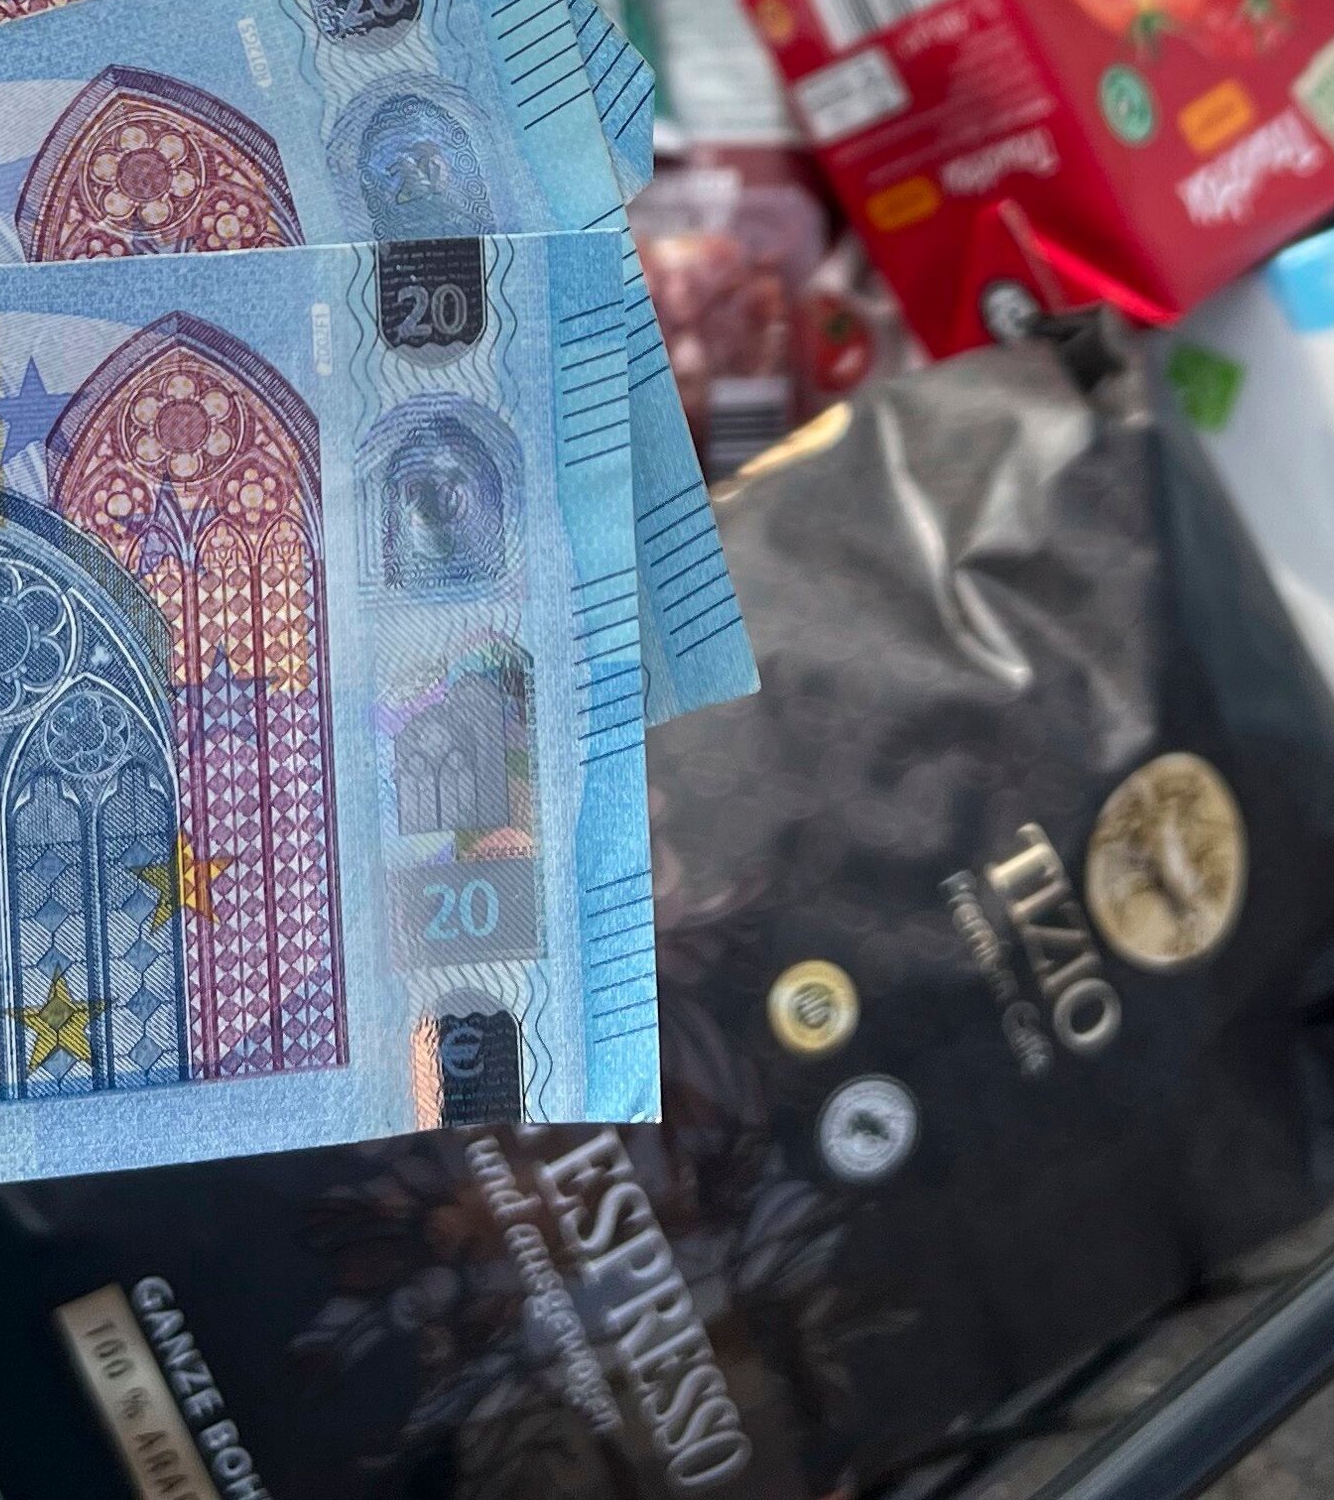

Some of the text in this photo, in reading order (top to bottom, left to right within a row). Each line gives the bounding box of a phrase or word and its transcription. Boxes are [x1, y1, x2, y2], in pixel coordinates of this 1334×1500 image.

[394, 283, 468, 344] 20
[421, 878, 500, 942] 20
[985, 821, 1123, 1055] TIZIO
[466, 1134, 542, 1222] und
[132, 1276, 225, 1419] GANZE
[538, 1128, 753, 1487] ESPRESSO
